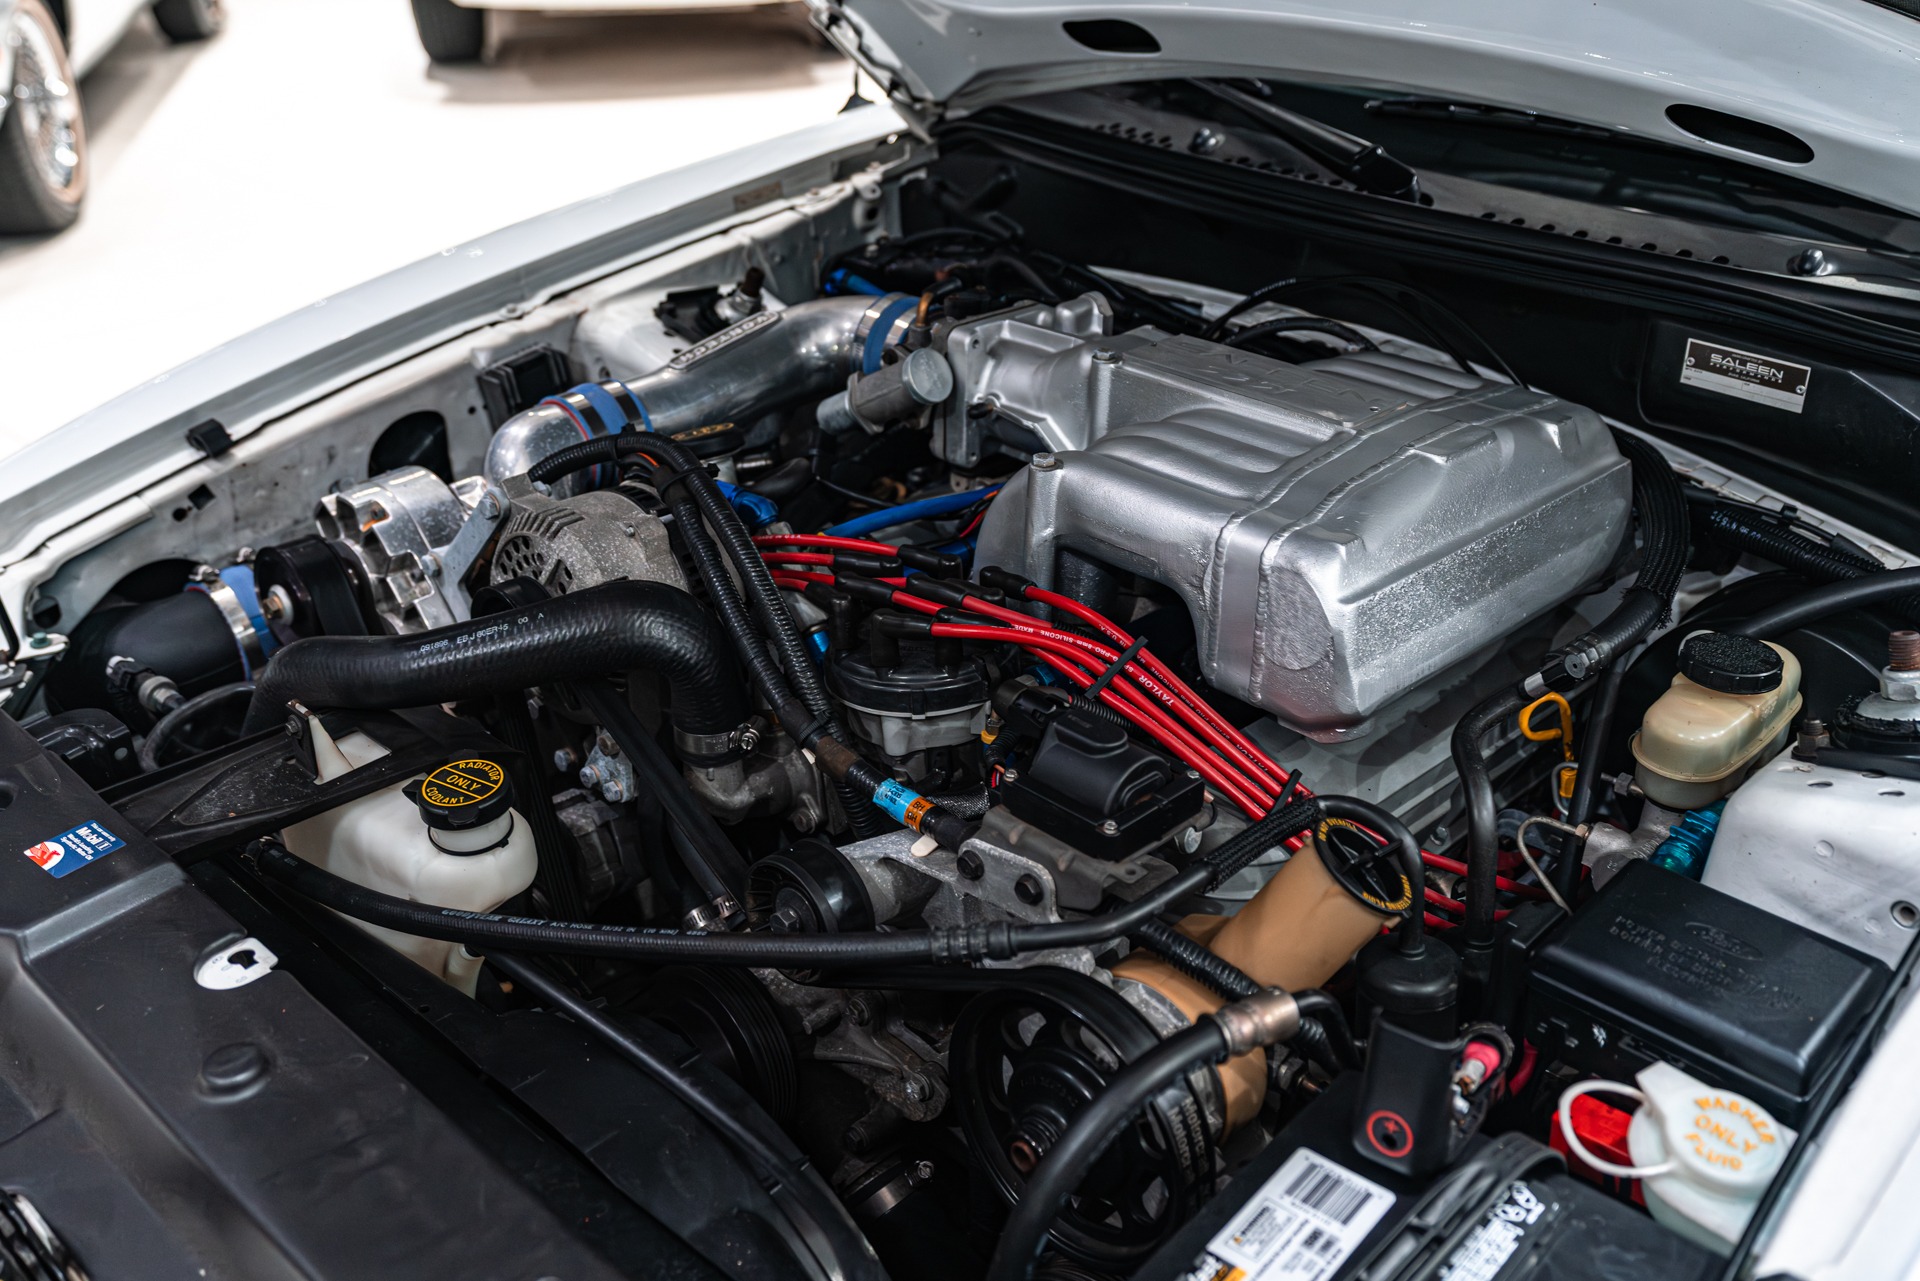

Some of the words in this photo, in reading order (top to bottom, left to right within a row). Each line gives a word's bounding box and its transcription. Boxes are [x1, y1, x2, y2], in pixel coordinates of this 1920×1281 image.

[1710, 353, 1784, 379] SALEEN
[1014, 623, 1034, 634] MADE
[1040, 629, 1074, 643] SILICONE
[1149, 666, 1179, 694] SILICONE
[1138, 674, 1175, 707] TAYLOR
[459, 761, 500, 781] RADIATOR
[446, 774, 482, 791] ONLY
[426, 786, 465, 804] COOLANT
[912, 801, 926, 812] BH
[76, 826, 103, 845] Mobil
[507, 916, 547, 926] GALAXY
[1694, 1096, 1776, 1144] WASHER
[1695, 1114, 1758, 1155] ONLY
[1685, 1133, 1743, 1171] FLUID
